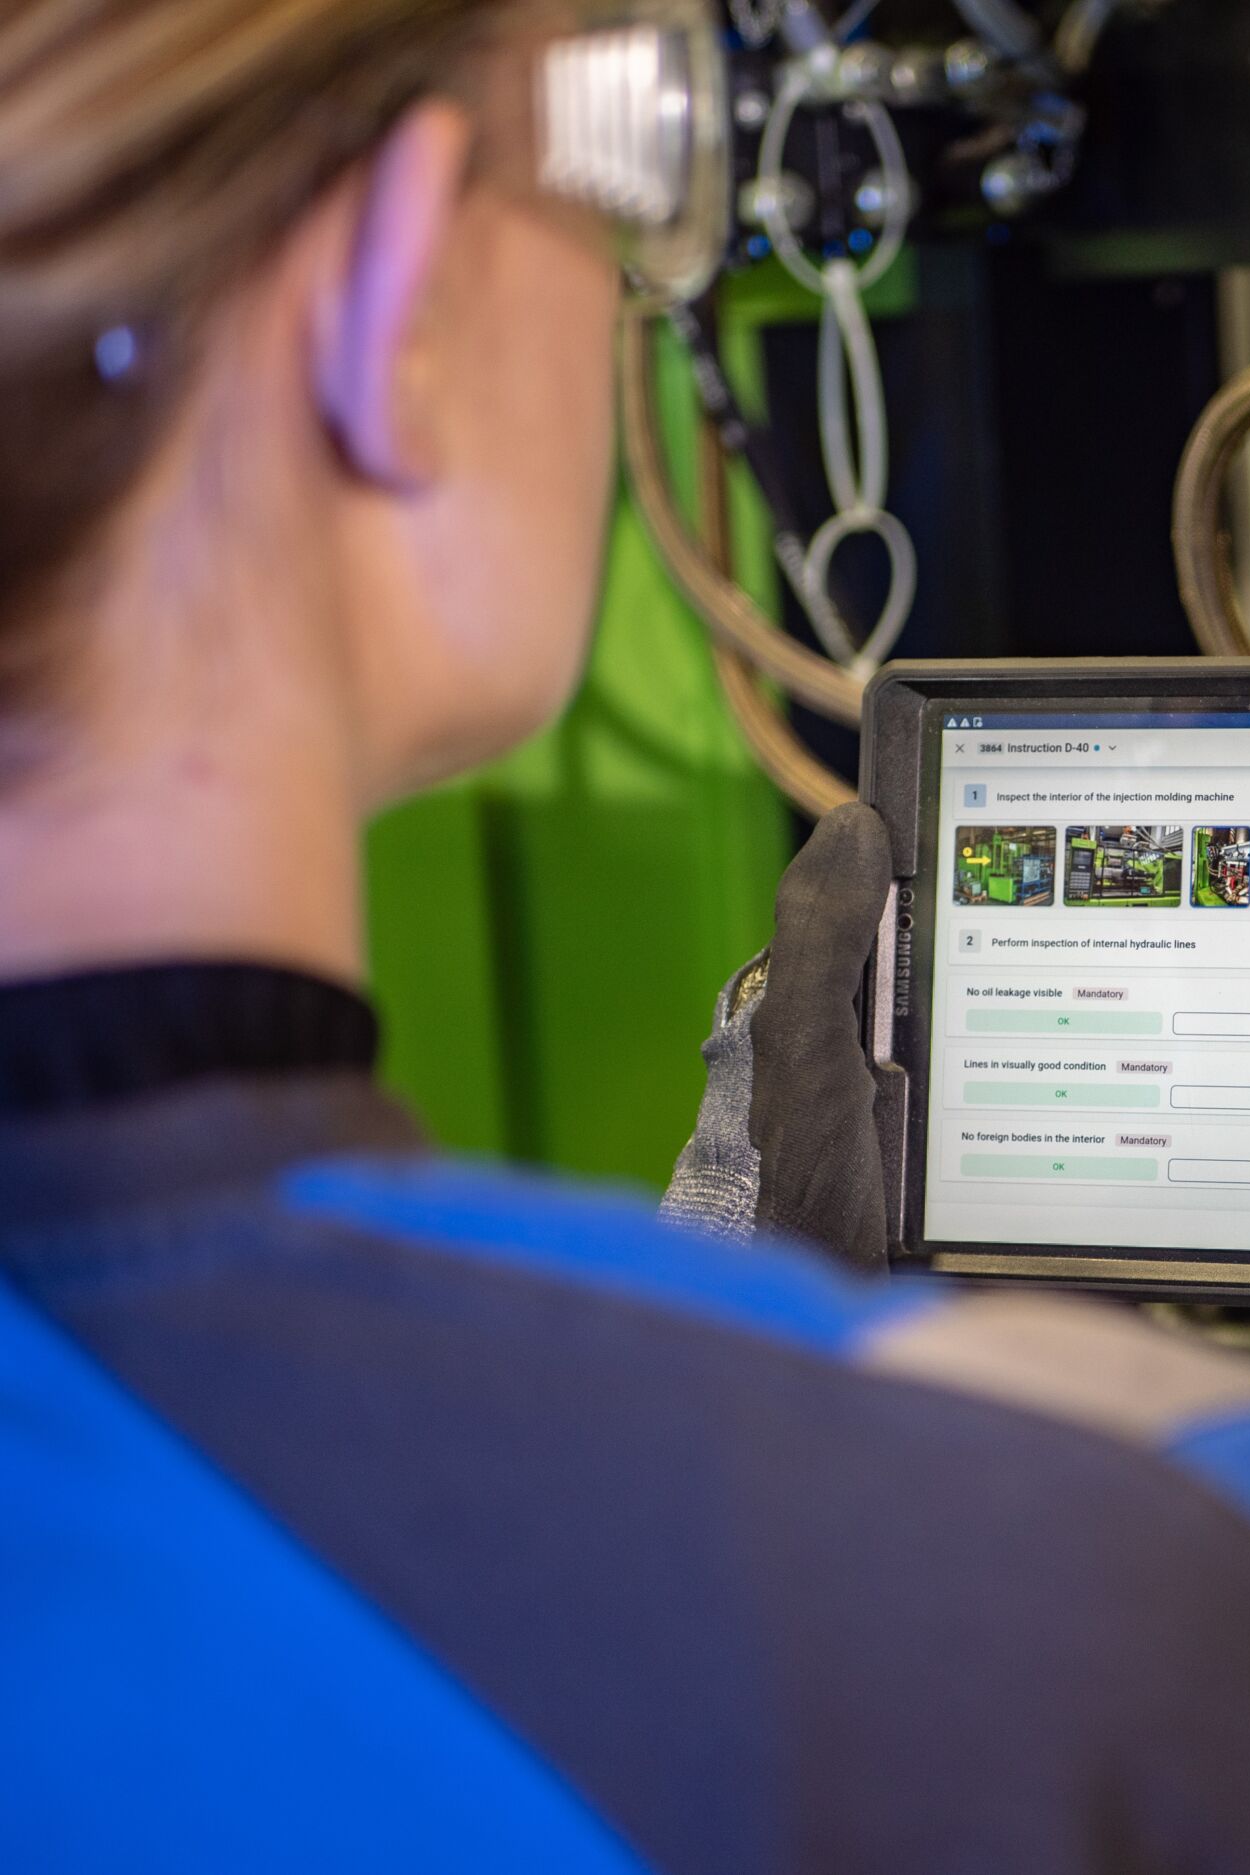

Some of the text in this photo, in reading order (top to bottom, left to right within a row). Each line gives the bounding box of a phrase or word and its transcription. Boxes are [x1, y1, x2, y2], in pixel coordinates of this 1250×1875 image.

[979, 742, 1090, 753] 3864 Instruction D-40
[996, 791, 1031, 804] Inspect
[1031, 791, 1048, 802] the
[1048, 792, 1083, 802] interior
[1083, 791, 1095, 802] of
[1095, 792, 1112, 802] the
[1112, 792, 1153, 804] injection
[1154, 791, 1193, 804] molding
[1194, 792, 1235, 802] machine
[991, 937, 1029, 948] Perform
[1030, 938, 1079, 950] inspection
[1080, 938, 1091, 948] of
[1092, 938, 1128, 949] internal
[1129, 938, 1172, 951] hydraulic
[1173, 939, 1197, 949] lines
[896, 932, 912, 1017] SAMSUNG
[966, 986, 1063, 1000] No oil leakage visible
[1077, 988, 1124, 1001] Mandatory
[1056, 1016, 1070, 1026] OK
[963, 1058, 1107, 1073] Lines in visually good condition
[1121, 1062, 1168, 1074] Mandatory
[1054, 1089, 1068, 1099] OK
[961, 1131, 1106, 1144] No foreign bodies in the interior
[1120, 1135, 1168, 1148] Mandatory
[1052, 1162, 1065, 1172] OK
